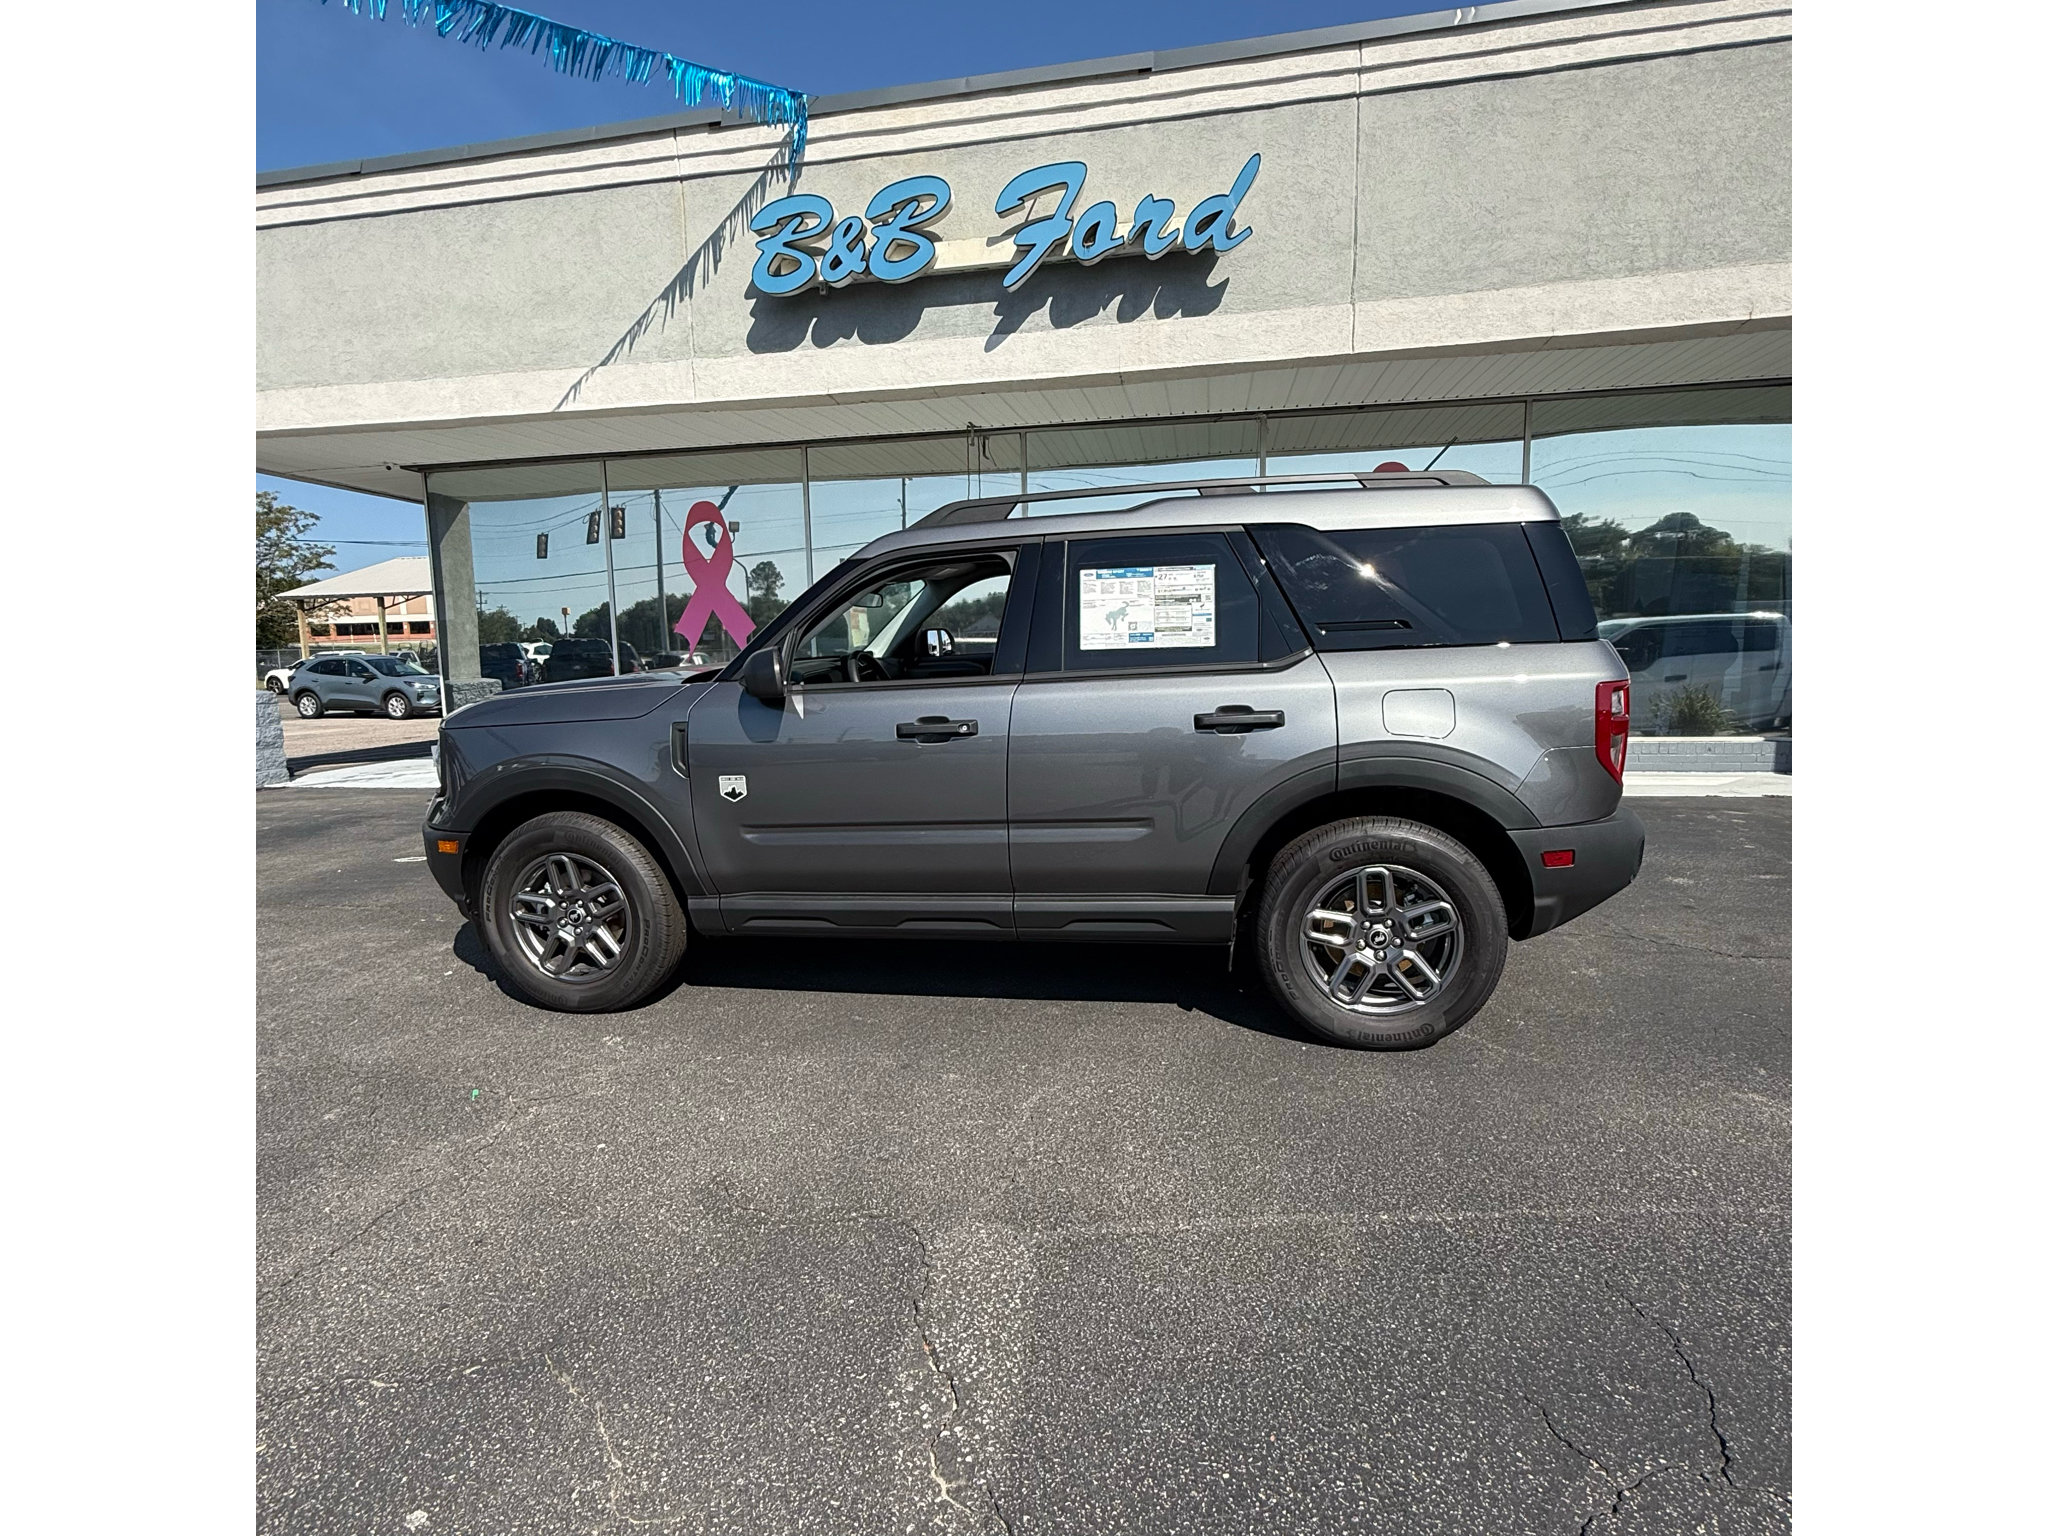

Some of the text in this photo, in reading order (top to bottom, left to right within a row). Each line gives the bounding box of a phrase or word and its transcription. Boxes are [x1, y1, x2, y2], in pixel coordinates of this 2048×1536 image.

[751, 152, 1262, 294] B&B Ford
[1328, 840, 1406, 862] Continental
[1356, 1023, 1435, 1043] Continental
